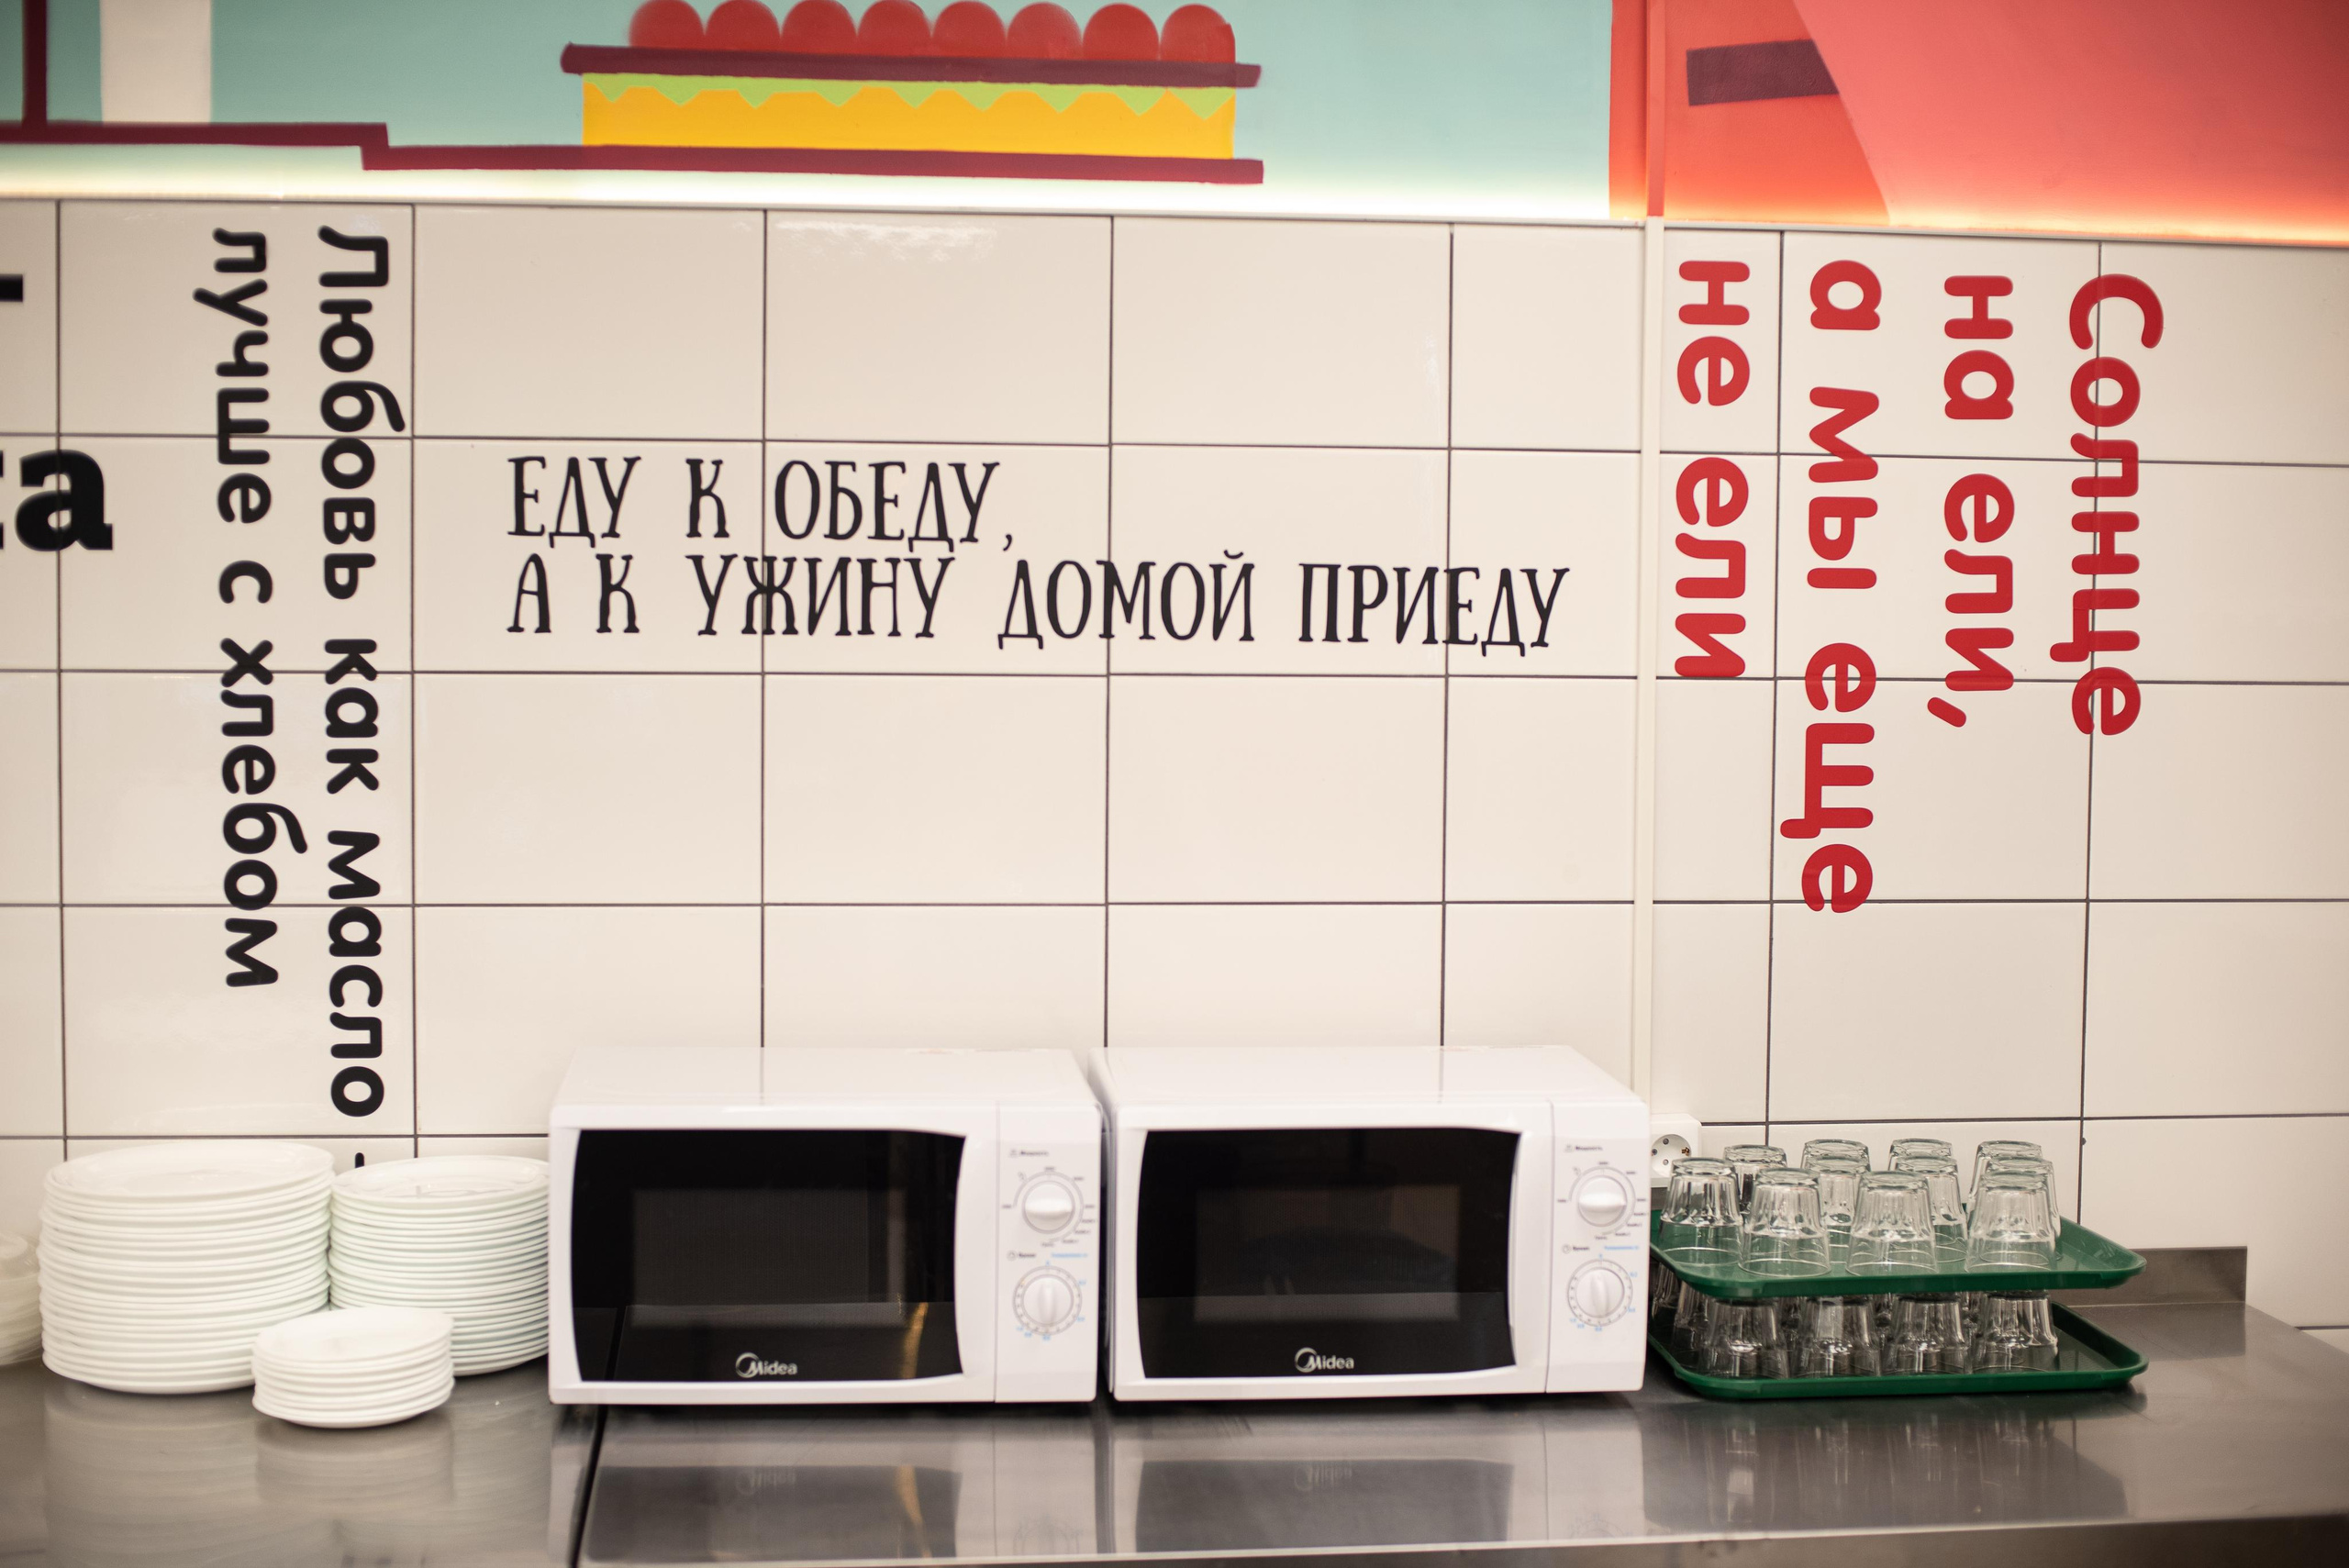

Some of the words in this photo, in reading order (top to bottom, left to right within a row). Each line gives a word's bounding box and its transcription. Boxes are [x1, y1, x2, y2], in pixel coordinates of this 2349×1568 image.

[193, 228, 272, 524] лучше
[1677, 261, 1750, 406] не
[1809, 260, 1882, 330] а
[1943, 275, 2015, 420] на
[318, 226, 405, 599] Любовь
[1807, 386, 1879, 589] мы
[219, 561, 273, 604] с
[507, 456, 641, 549] ЕДУ
[685, 458, 729, 539] К
[774, 460, 1013, 552] ОБЕДУ,
[1675, 457, 1749, 677] ели
[2049, 273, 2164, 736] Солнце
[507, 553, 552, 634] А
[596, 553, 640, 634] К
[685, 553, 955, 639] УЖИНУ
[997, 550, 1255, 650] ДОМОЙ
[1298, 563, 1570, 657] ПРИЕДУ
[1927, 473, 2015, 728] ели,
[323, 639, 385, 794] как
[1780, 643, 1876, 913] еще
[220, 638, 307, 987] хлебом
[328, 830, 384, 1118] масло
[735, 1351, 797, 1378] Midea
[1295, 1347, 1354, 1373] Midea
